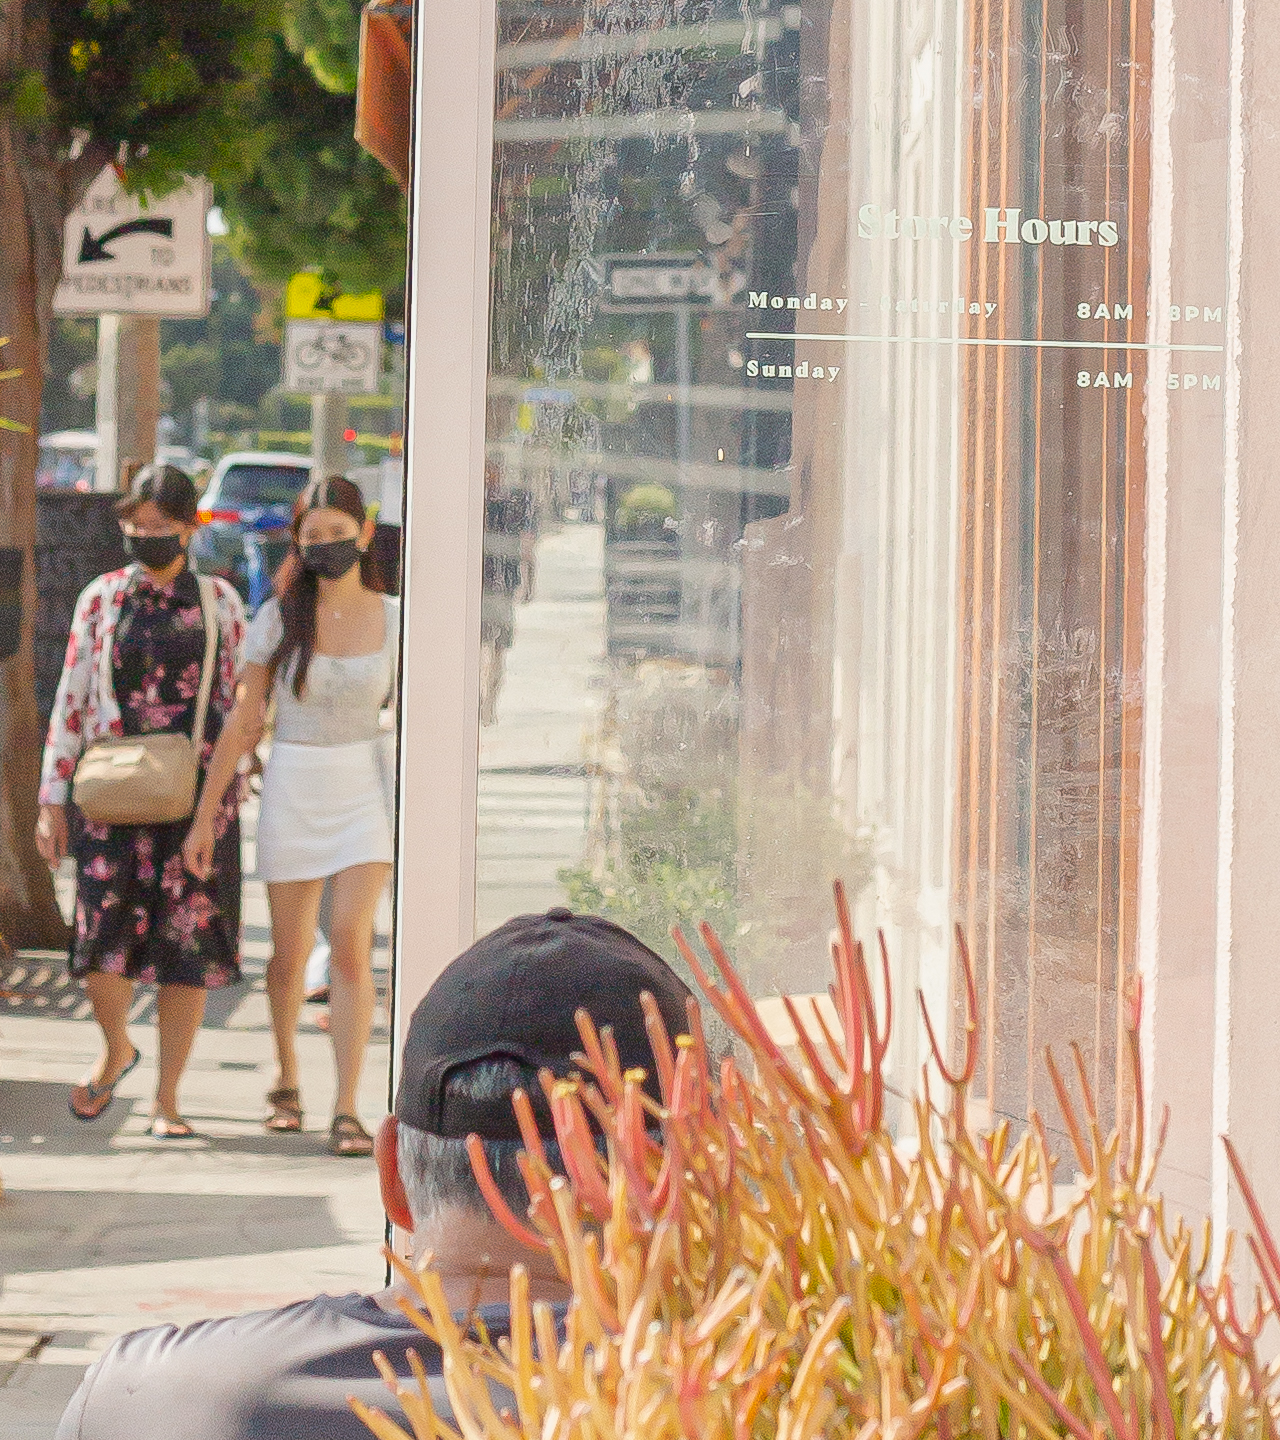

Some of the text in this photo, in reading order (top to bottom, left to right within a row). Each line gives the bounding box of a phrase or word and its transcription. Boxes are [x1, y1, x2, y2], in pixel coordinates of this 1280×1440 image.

[857, 203, 1119, 247] Store Hours
[747, 291, 849, 315] Monday
[880, 294, 998, 319] Saturday
[1076, 302, 1133, 321] 8AM
[1169, 305, 1222, 323] 8PM
[746, 359, 1221, 391] Sunday 8AM 5PM
